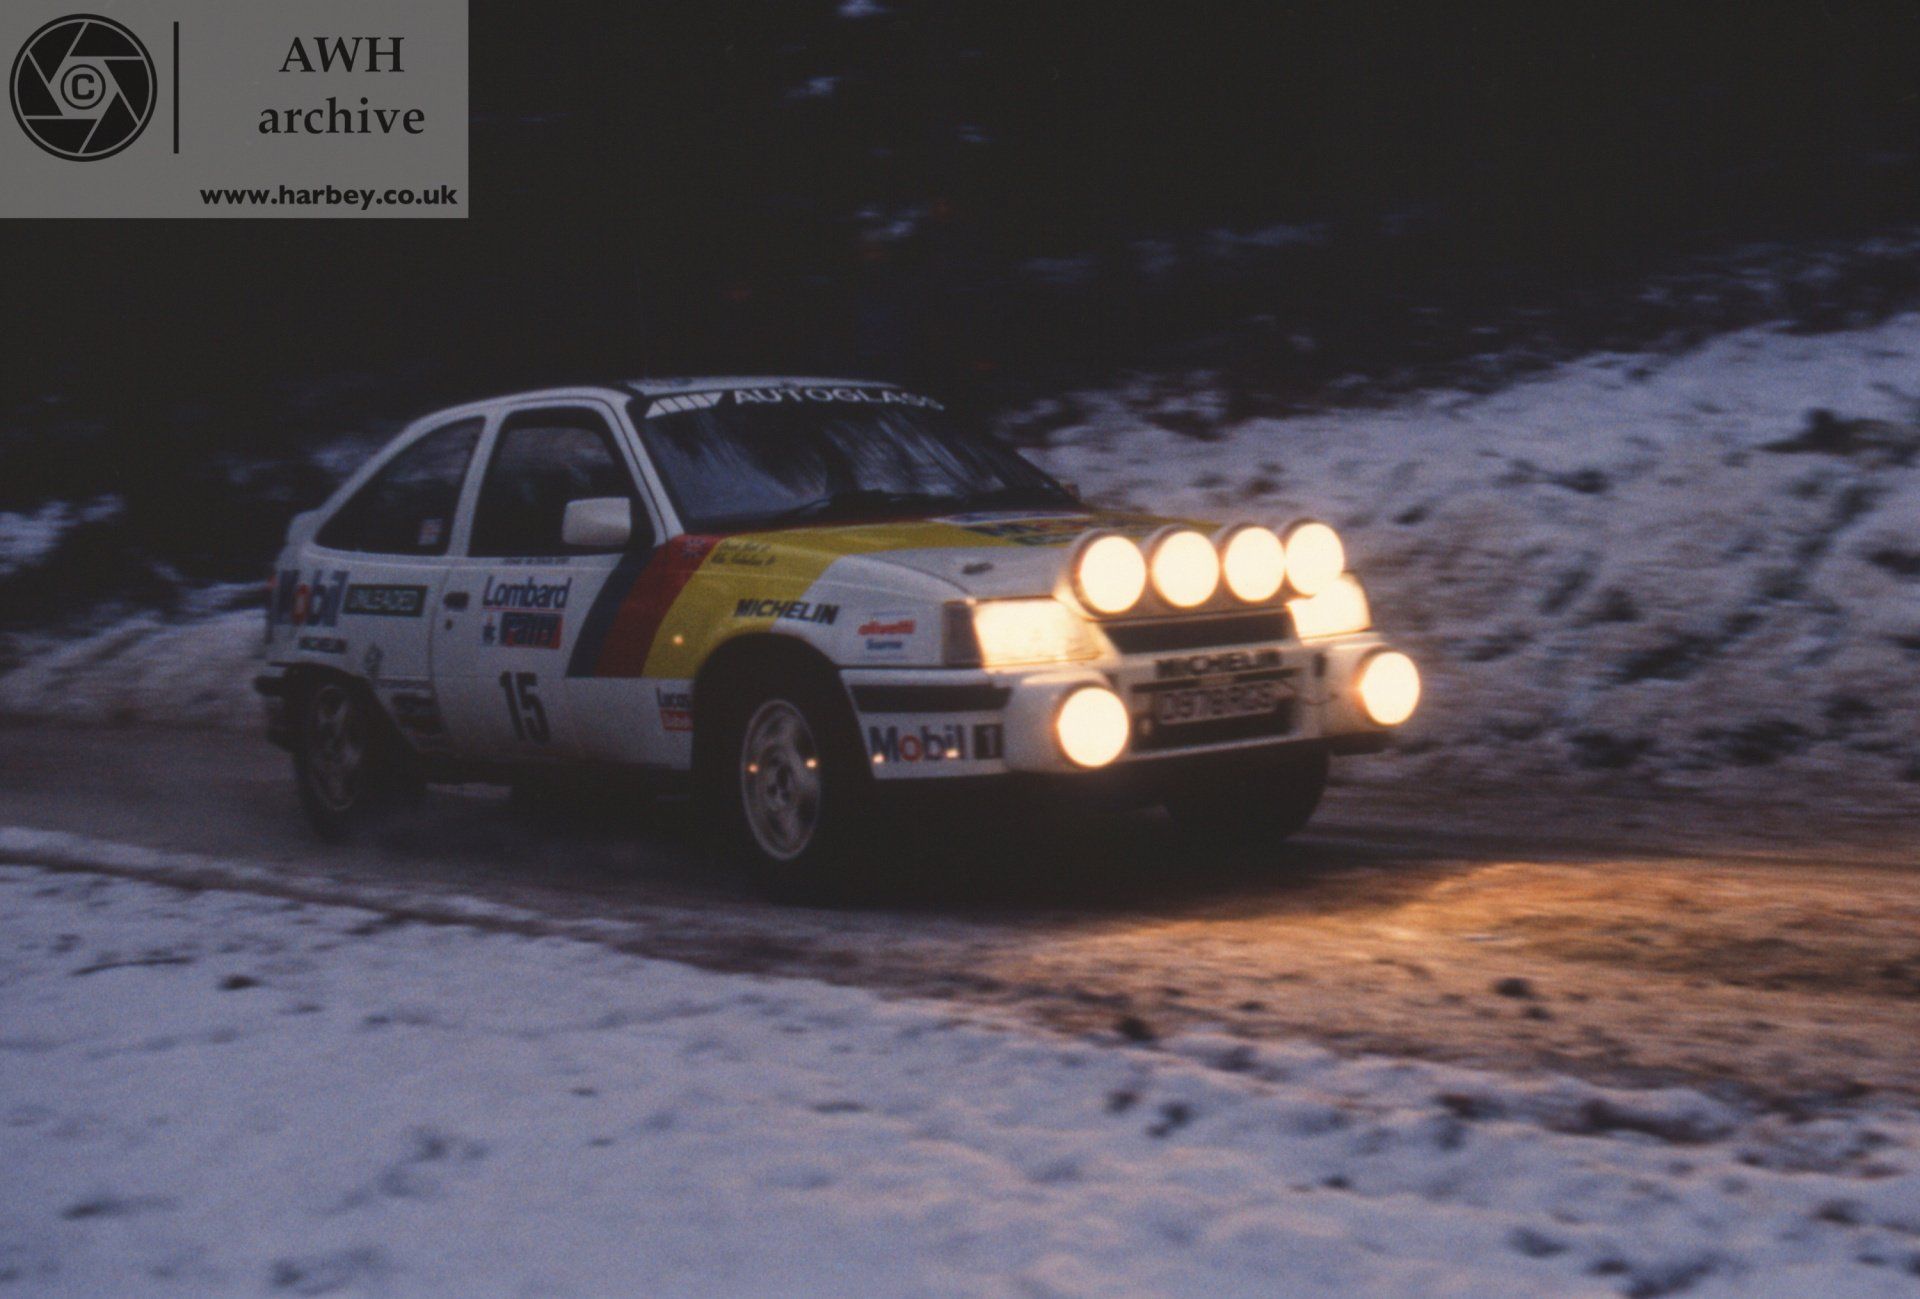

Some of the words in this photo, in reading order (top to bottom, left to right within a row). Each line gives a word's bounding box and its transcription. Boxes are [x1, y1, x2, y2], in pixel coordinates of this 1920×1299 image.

[482, 574, 573, 609] Lombard
[732, 598, 840, 626] MICHELIN
[499, 670, 550, 743] 15
[868, 724, 965, 762] Mobil
